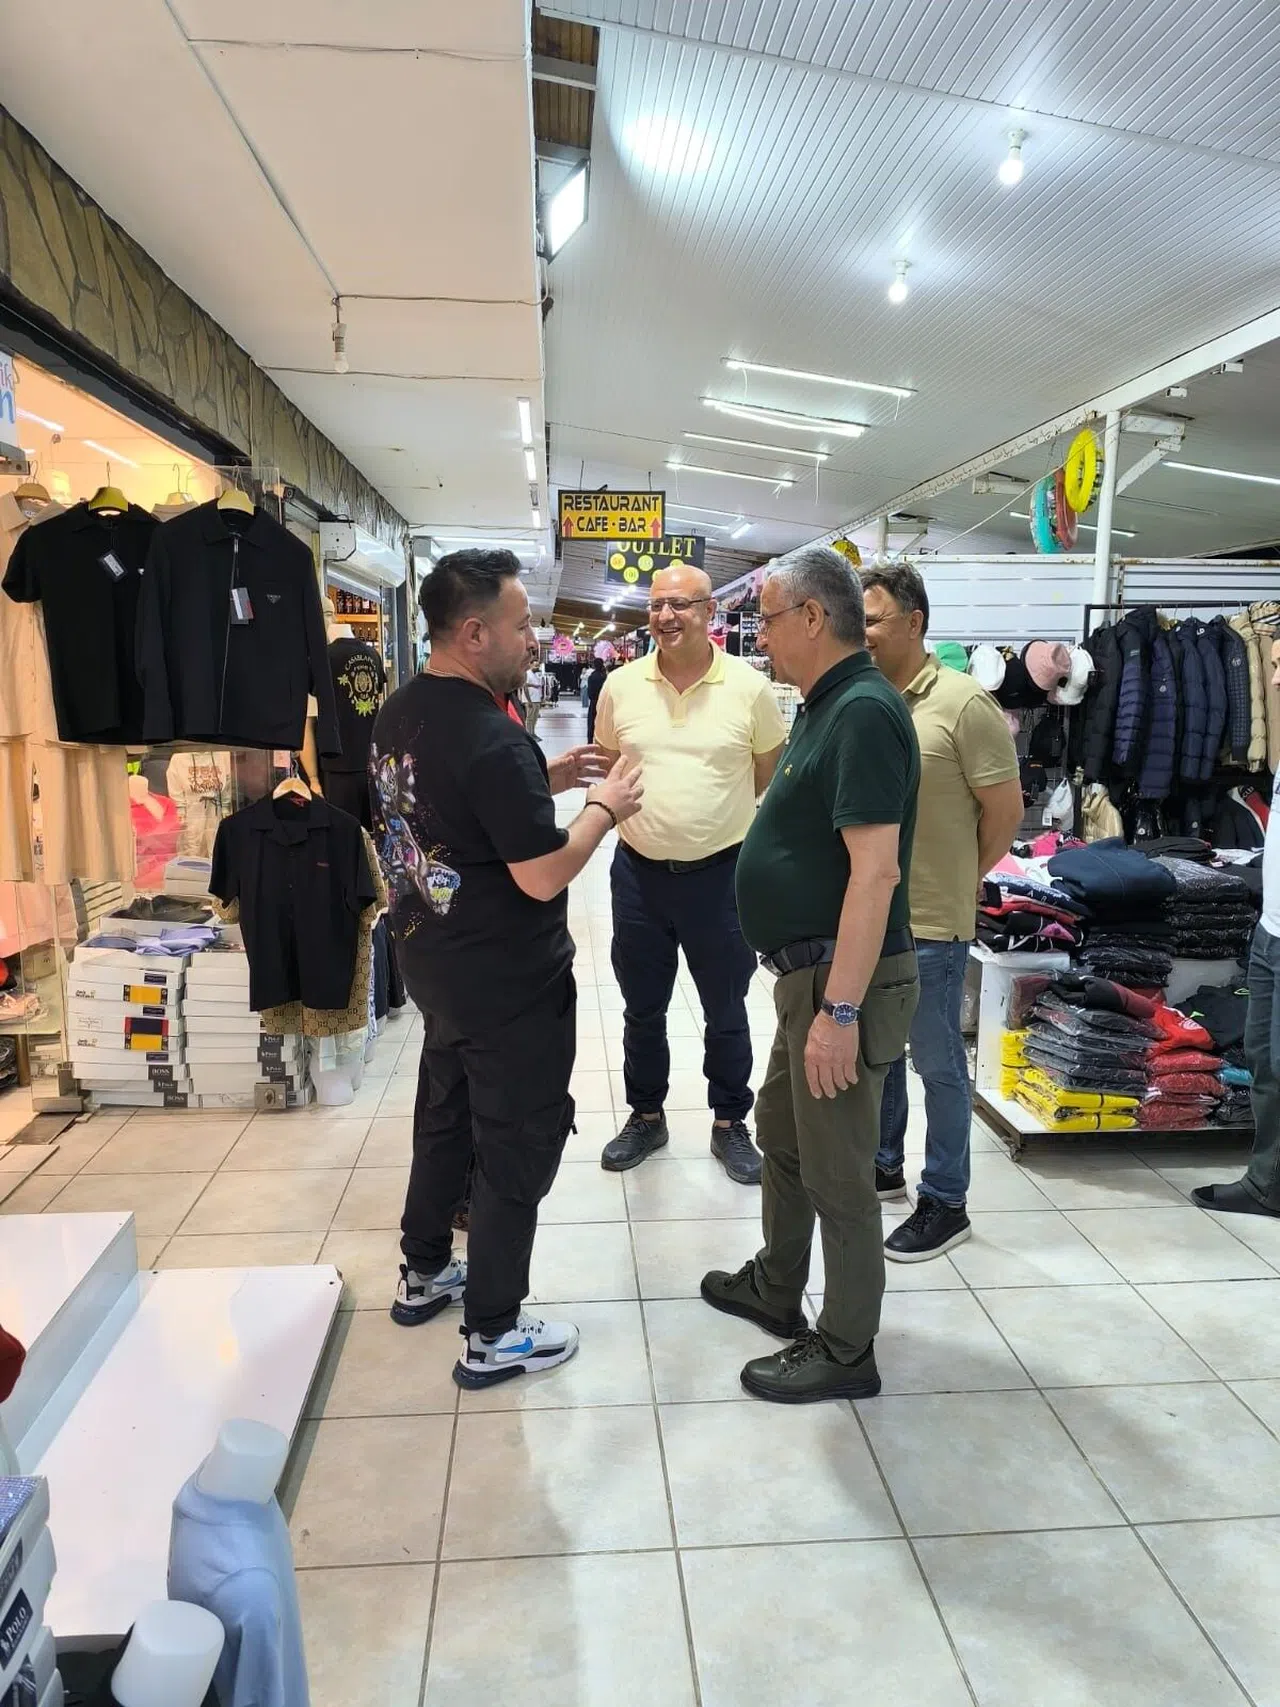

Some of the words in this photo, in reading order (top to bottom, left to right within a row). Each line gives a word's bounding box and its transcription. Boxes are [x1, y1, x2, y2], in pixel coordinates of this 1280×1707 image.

[563, 495, 660, 512] RESTAURANT
[576, 516, 608, 532] CAFE
[618, 517, 647, 533] BAR
[4, 1605, 27, 1641] POLO
